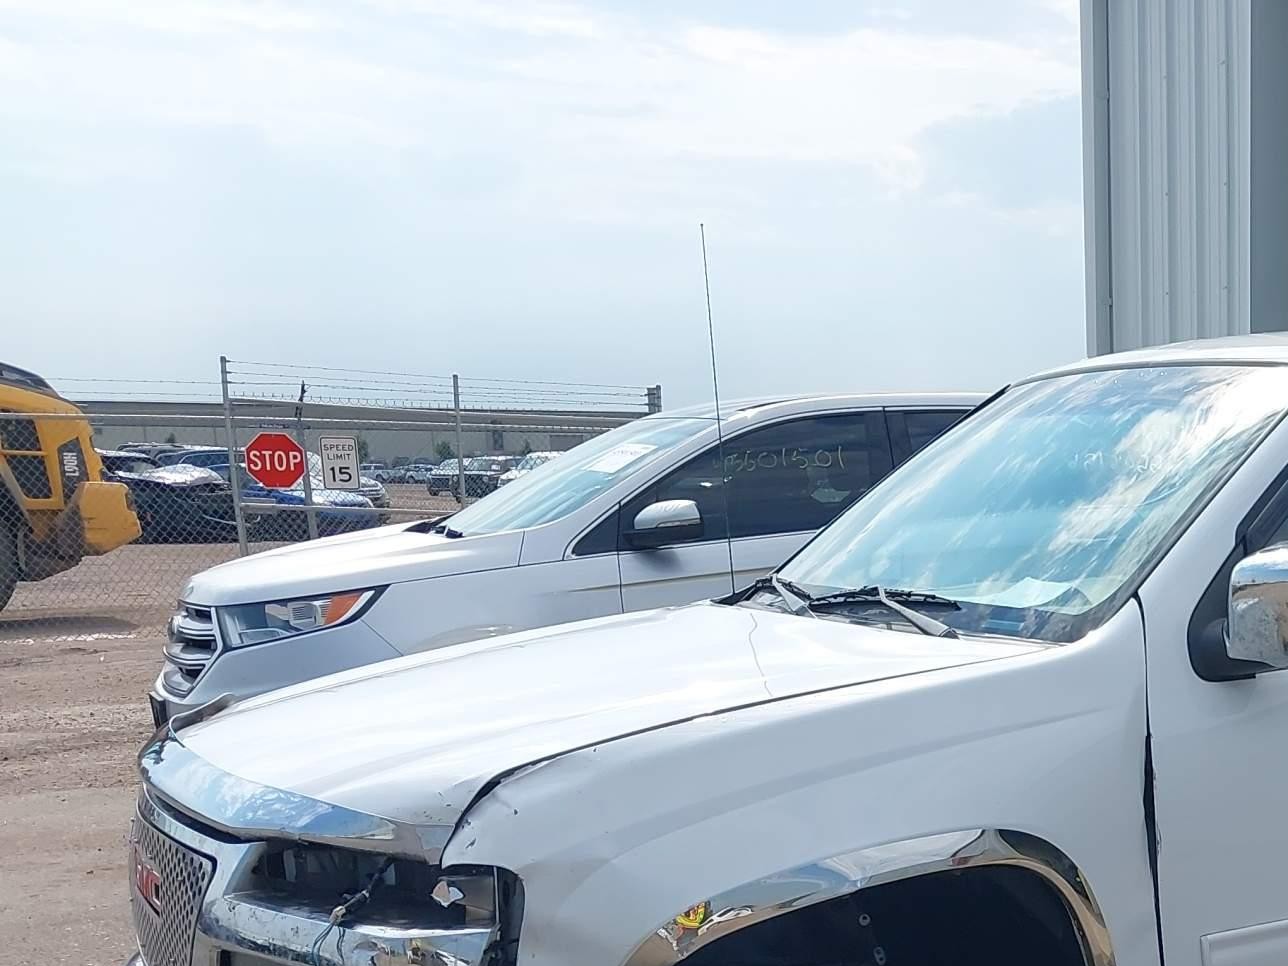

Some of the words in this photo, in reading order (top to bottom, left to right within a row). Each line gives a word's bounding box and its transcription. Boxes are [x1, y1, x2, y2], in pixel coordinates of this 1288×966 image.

[323, 444, 354, 452] SPEED
[249, 450, 301, 472] STOP
[327, 453, 351, 461] LIMIT
[330, 466, 352, 482] 15
